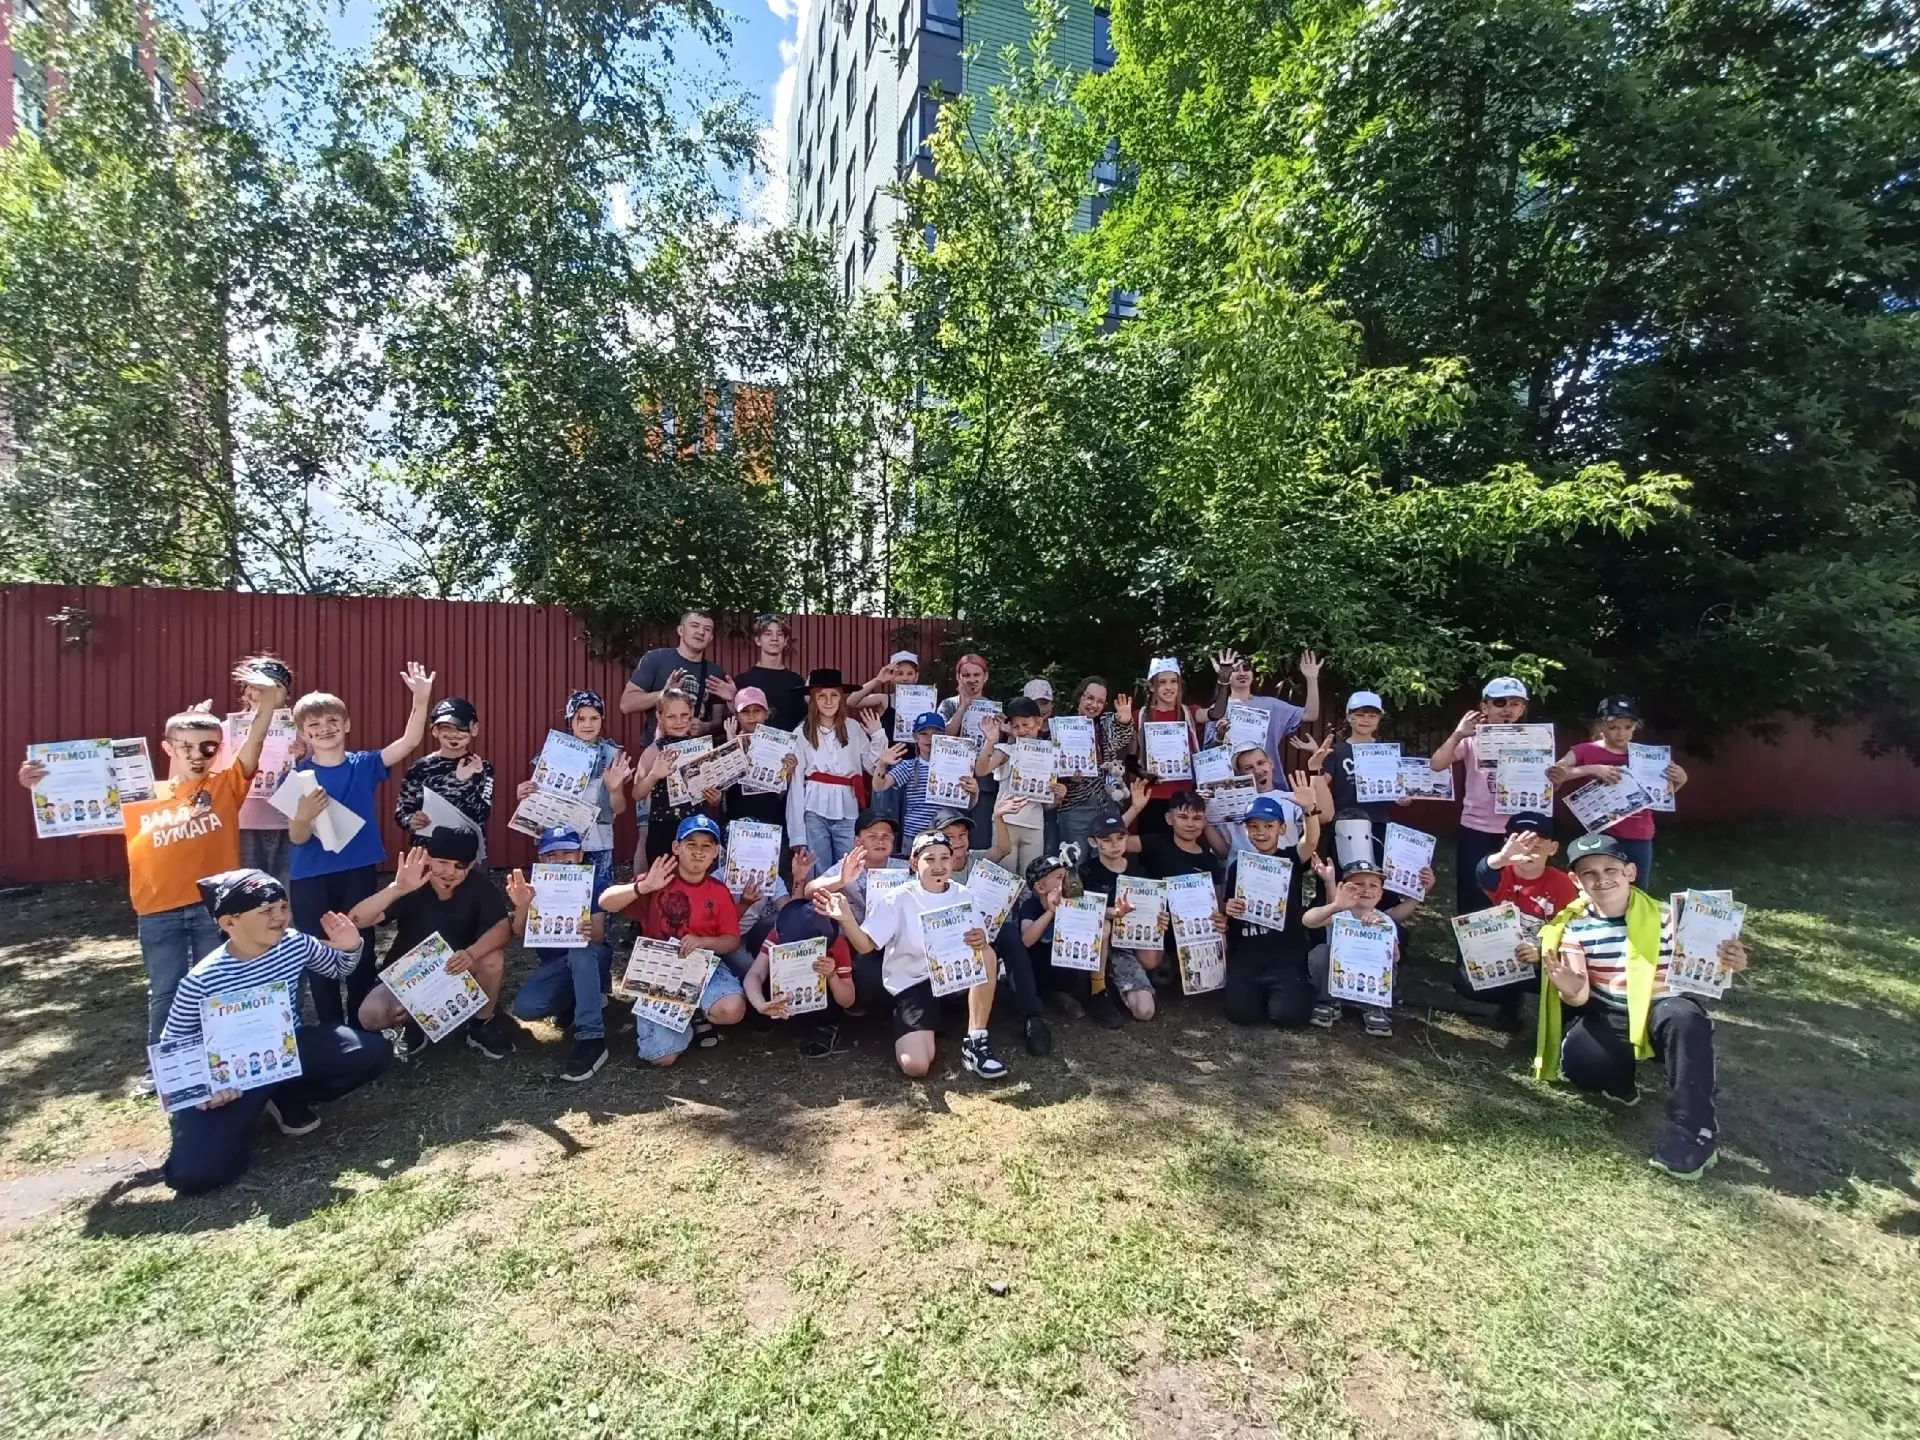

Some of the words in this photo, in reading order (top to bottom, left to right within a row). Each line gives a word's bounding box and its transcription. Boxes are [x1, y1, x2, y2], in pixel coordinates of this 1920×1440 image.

[1235, 715, 1262, 725] ГРАМОТА
[245, 728, 285, 737] ГОТА
[761, 733, 789, 745] ГРАМОТА
[556, 738, 588, 753] ГРАМОТА
[1023, 744, 1053, 754] ГРАМОТА
[47, 750, 100, 762] ГРАМОТА
[941, 747, 969, 757] ГРАМОТА
[1635, 751, 1665, 760] ГРАМОТА
[153, 812, 223, 848] БУМАГА
[741, 830, 773, 839] ГРАМОТА
[1397, 833, 1427, 847] ГРАМОТА
[1248, 860, 1281, 874] ГРАМОТА
[544, 873, 583, 881] ГРАМОТА
[979, 871, 1011, 887] ГРАМОТА
[1173, 880, 1205, 890] ГРАМОТА
[1125, 887, 1159, 896] ГРАМОТА
[1064, 901, 1097, 911] ГРАМОТА
[1695, 903, 1733, 921] ГРАМОТА
[932, 915, 966, 930] ГРАМОТА
[1344, 928, 1382, 941] ГРАМОТА
[1467, 922, 1509, 938] ГРАМОТА
[781, 948, 817, 960] ГРАМОТА
[406, 958, 444, 989] ГРАМОТА
[218, 996, 274, 1016] ГРАМОТА
